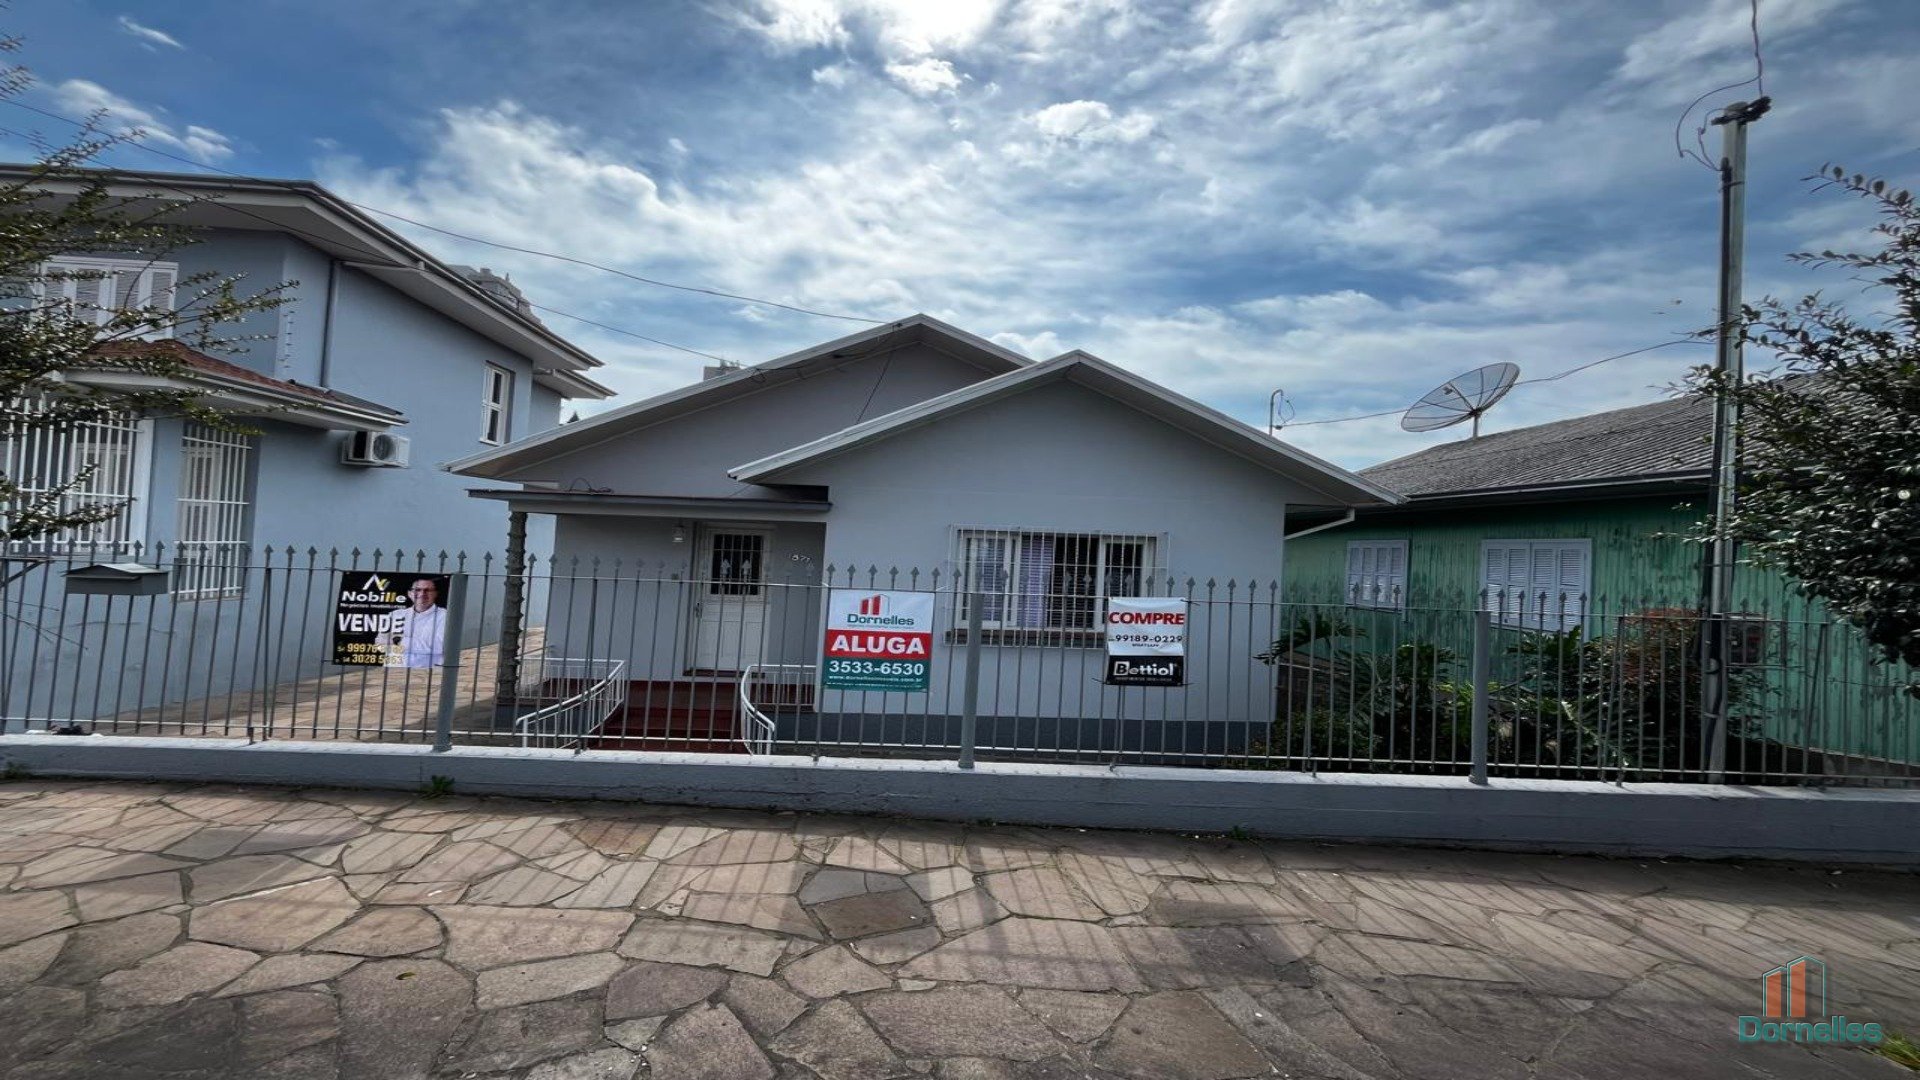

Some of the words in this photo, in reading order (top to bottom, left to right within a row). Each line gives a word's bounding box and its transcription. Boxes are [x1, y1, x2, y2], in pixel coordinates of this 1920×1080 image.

[342, 591, 407, 603] Nobille
[339, 613, 405, 633] VENDE
[847, 613, 914, 626] Dornelles
[1109, 611, 1185, 625] COMPRE
[831, 634, 925, 655] ALUGA
[1115, 634, 1183, 643] 99189-0229
[829, 660, 924, 676] 3533-6530
[1114, 662, 1174, 676] Bettiol
